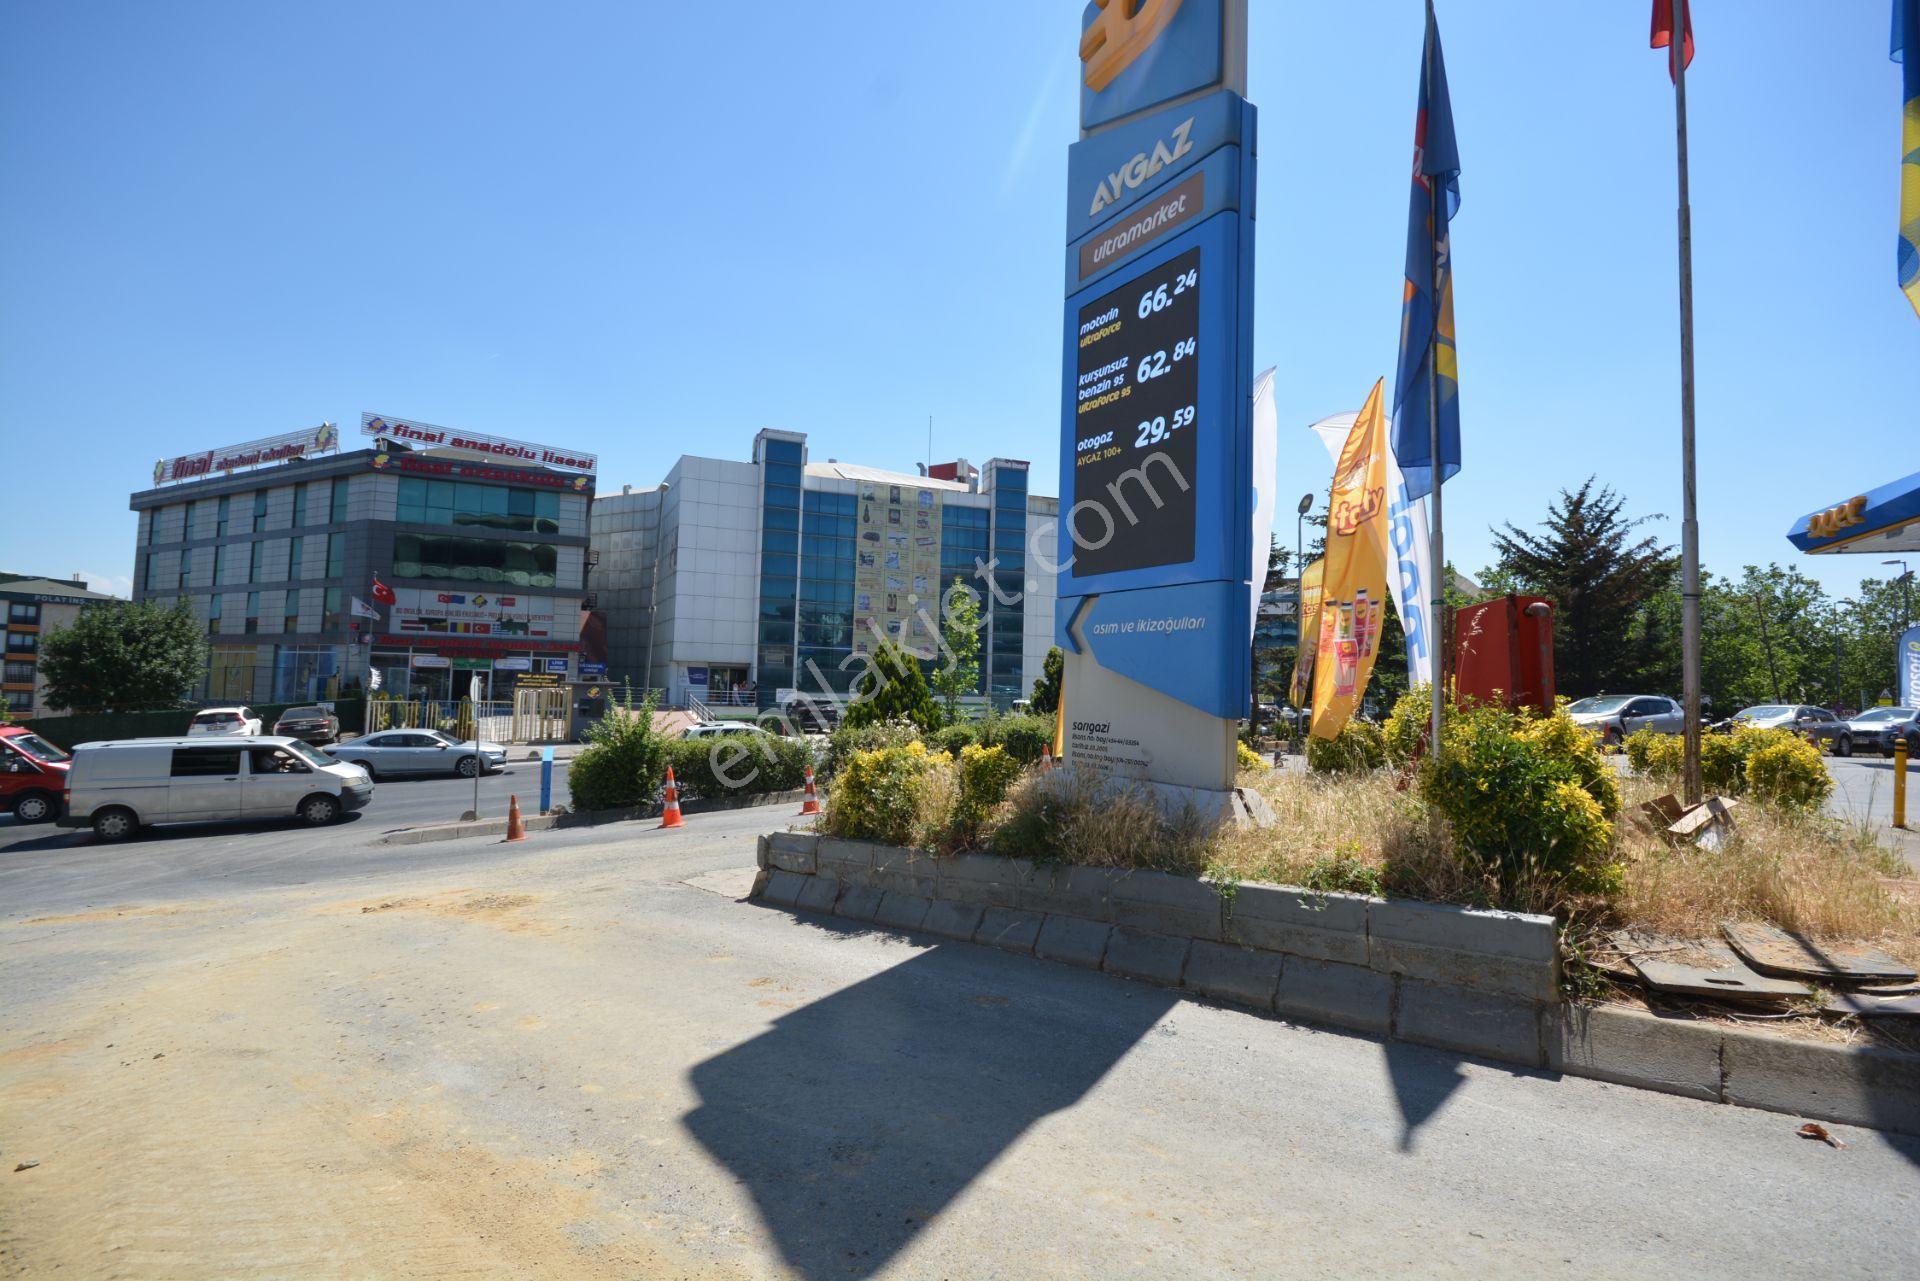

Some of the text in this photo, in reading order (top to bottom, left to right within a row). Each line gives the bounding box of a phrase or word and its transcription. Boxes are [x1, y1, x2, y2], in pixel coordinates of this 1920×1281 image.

[1089, 116, 1195, 217] AYGAZ
[1093, 194, 1187, 263] ultramarket
[1080, 268, 1197, 335] motorin 66.24
[1080, 321, 1122, 348] ultraforce
[1079, 336, 1196, 386] kurşunsuz 62.84
[1078, 386, 1132, 414] ultraforce 95
[1079, 373, 1125, 400] benzin 95
[1077, 405, 1195, 452] otogaz 29.59
[393, 423, 594, 470] final anadolu lisesi
[1077, 446, 1122, 467] AYGAZ 100+
[172, 450, 214, 480] final
[34, 594, 65, 604] POLAT
[1093, 616, 1206, 634] asım ve ikizoğulları
[1072, 721, 1110, 734] sarıgazi
